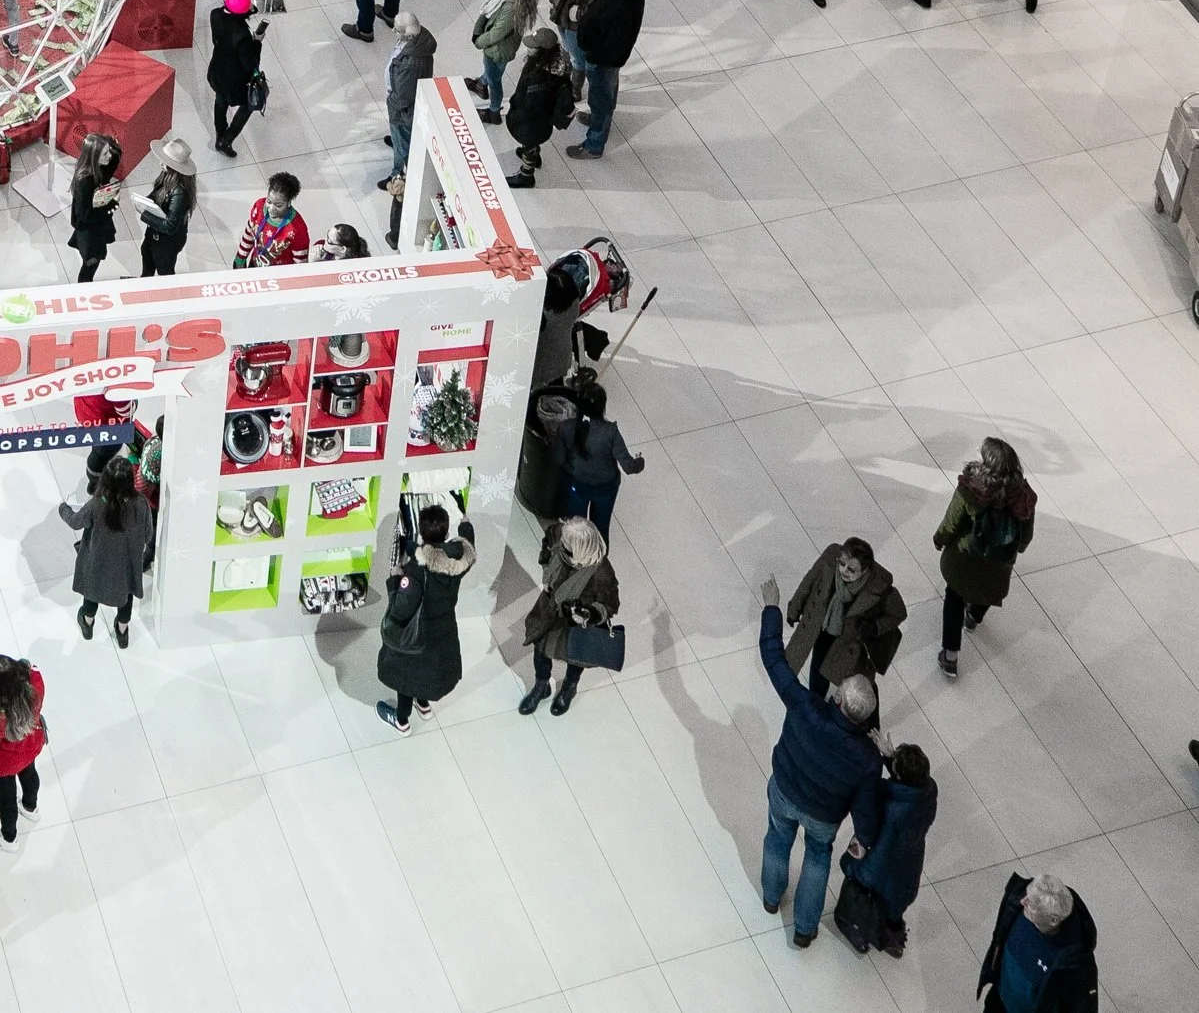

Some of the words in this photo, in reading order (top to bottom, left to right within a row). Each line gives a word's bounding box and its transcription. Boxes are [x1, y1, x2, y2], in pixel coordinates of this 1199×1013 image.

[447, 107, 501, 210] #GIVEJOYSHOP
[200, 279, 280, 298] #KOHLS
[337, 266, 419, 285] @KOHLS
[430, 323, 454, 331] GIVE
[442, 328, 472, 337] HOME
[23, 378, 66, 403] JOY
[73, 363, 137, 387] SHOP
[49, 421, 67, 431] TO
[74, 417, 102, 429] YOU
[108, 417, 126, 427] BY
